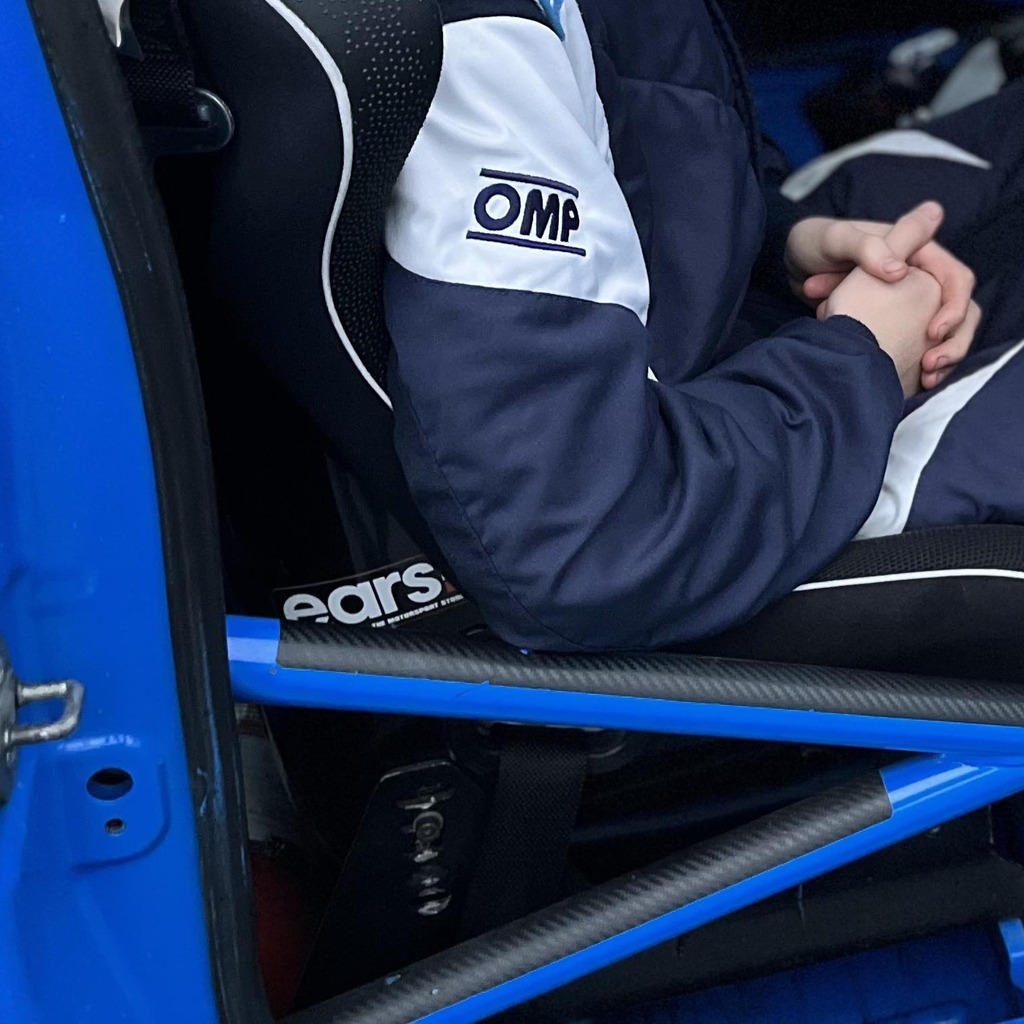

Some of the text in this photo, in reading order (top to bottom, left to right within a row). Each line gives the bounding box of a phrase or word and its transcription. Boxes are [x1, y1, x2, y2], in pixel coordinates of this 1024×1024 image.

[473, 183, 580, 242] OMP
[371, 620, 386, 628] THE
[387, 602, 438, 624] MOTORSPORT
